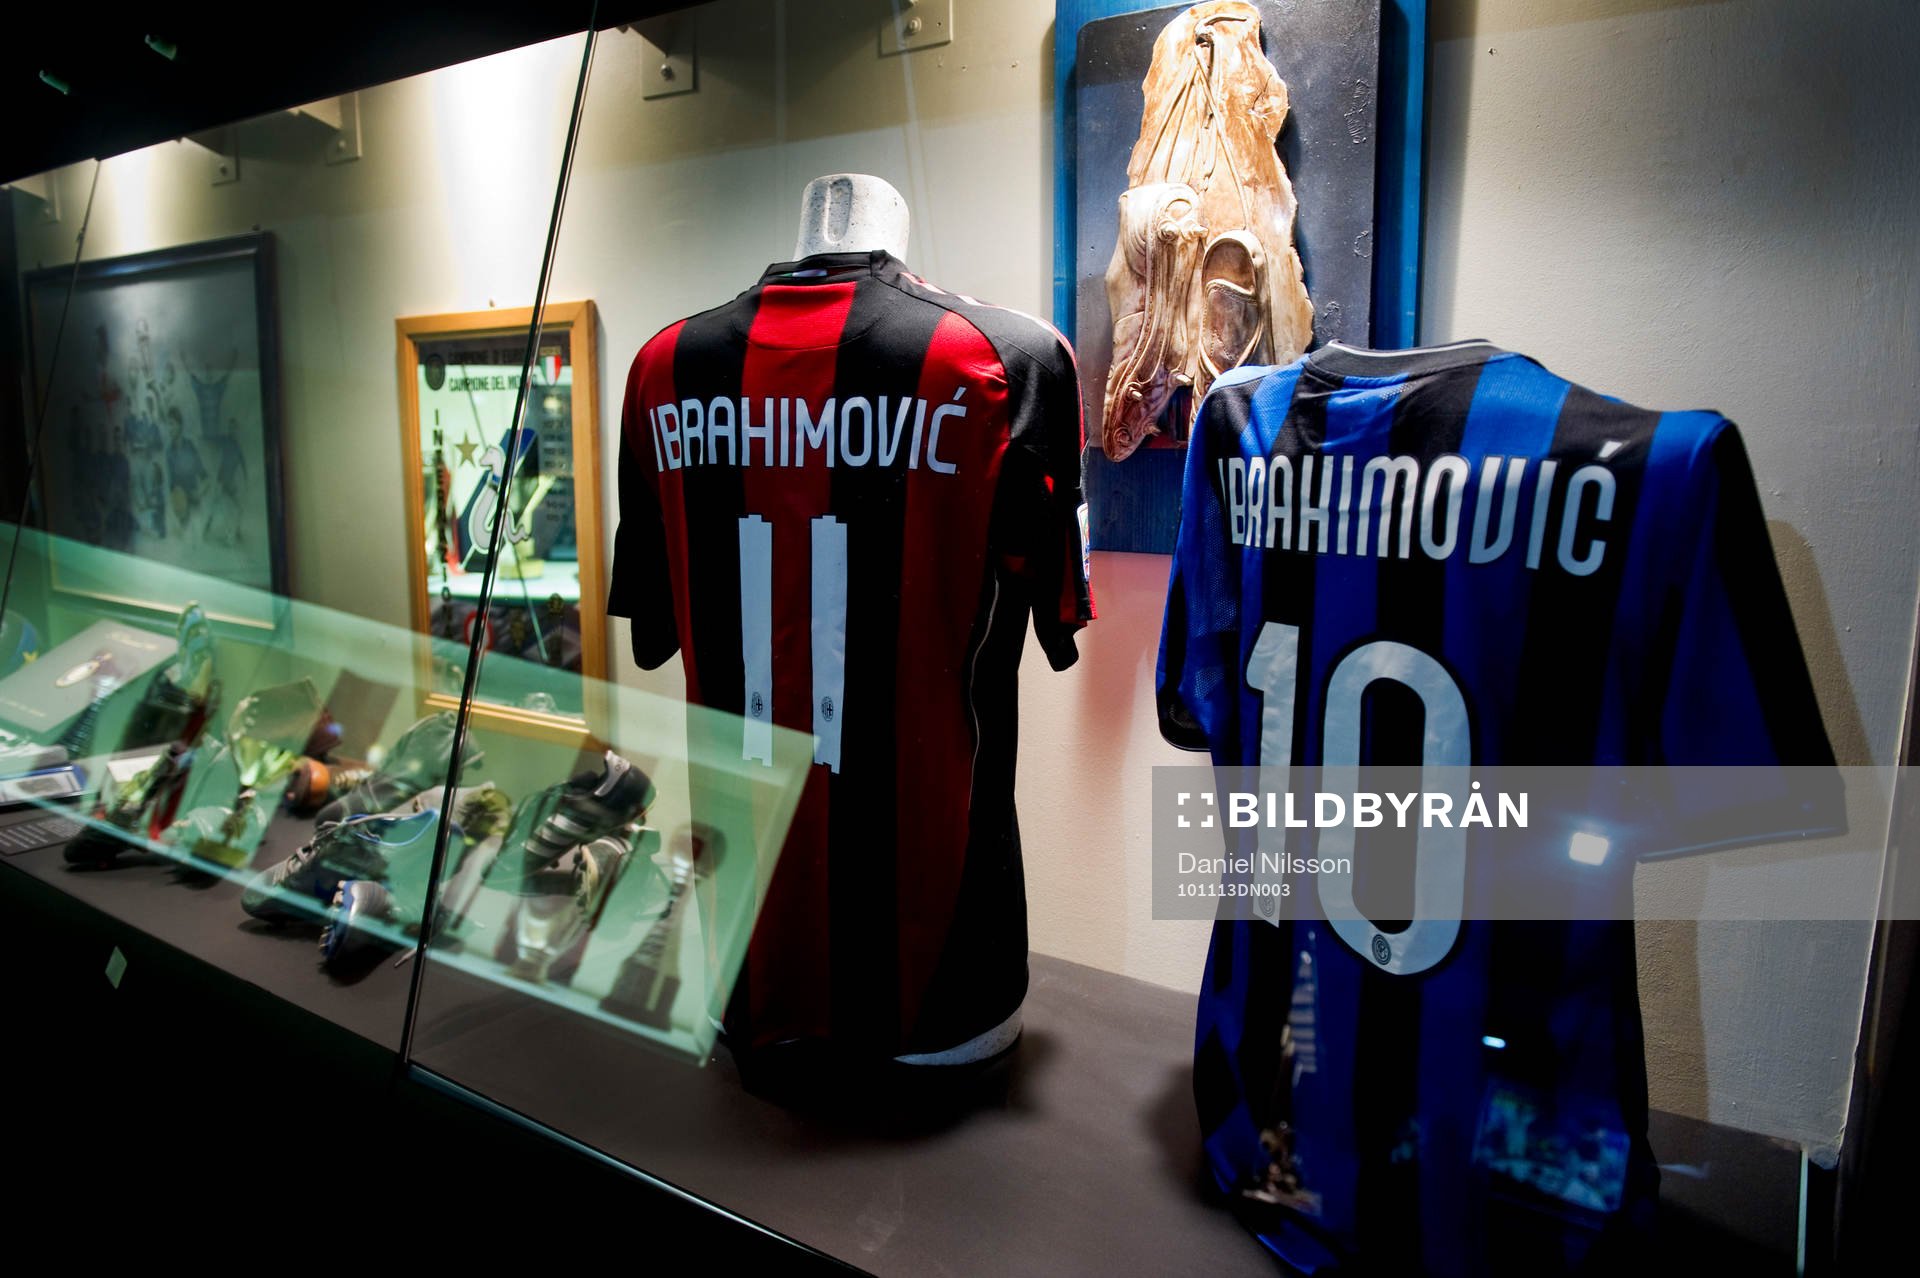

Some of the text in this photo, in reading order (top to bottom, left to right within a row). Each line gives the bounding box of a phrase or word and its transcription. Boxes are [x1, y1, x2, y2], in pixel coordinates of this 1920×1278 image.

[649, 386, 967, 474] IBRAHIMOVIĆ
[738, 514, 848, 774] 11
[1245, 620, 1471, 975] 10
